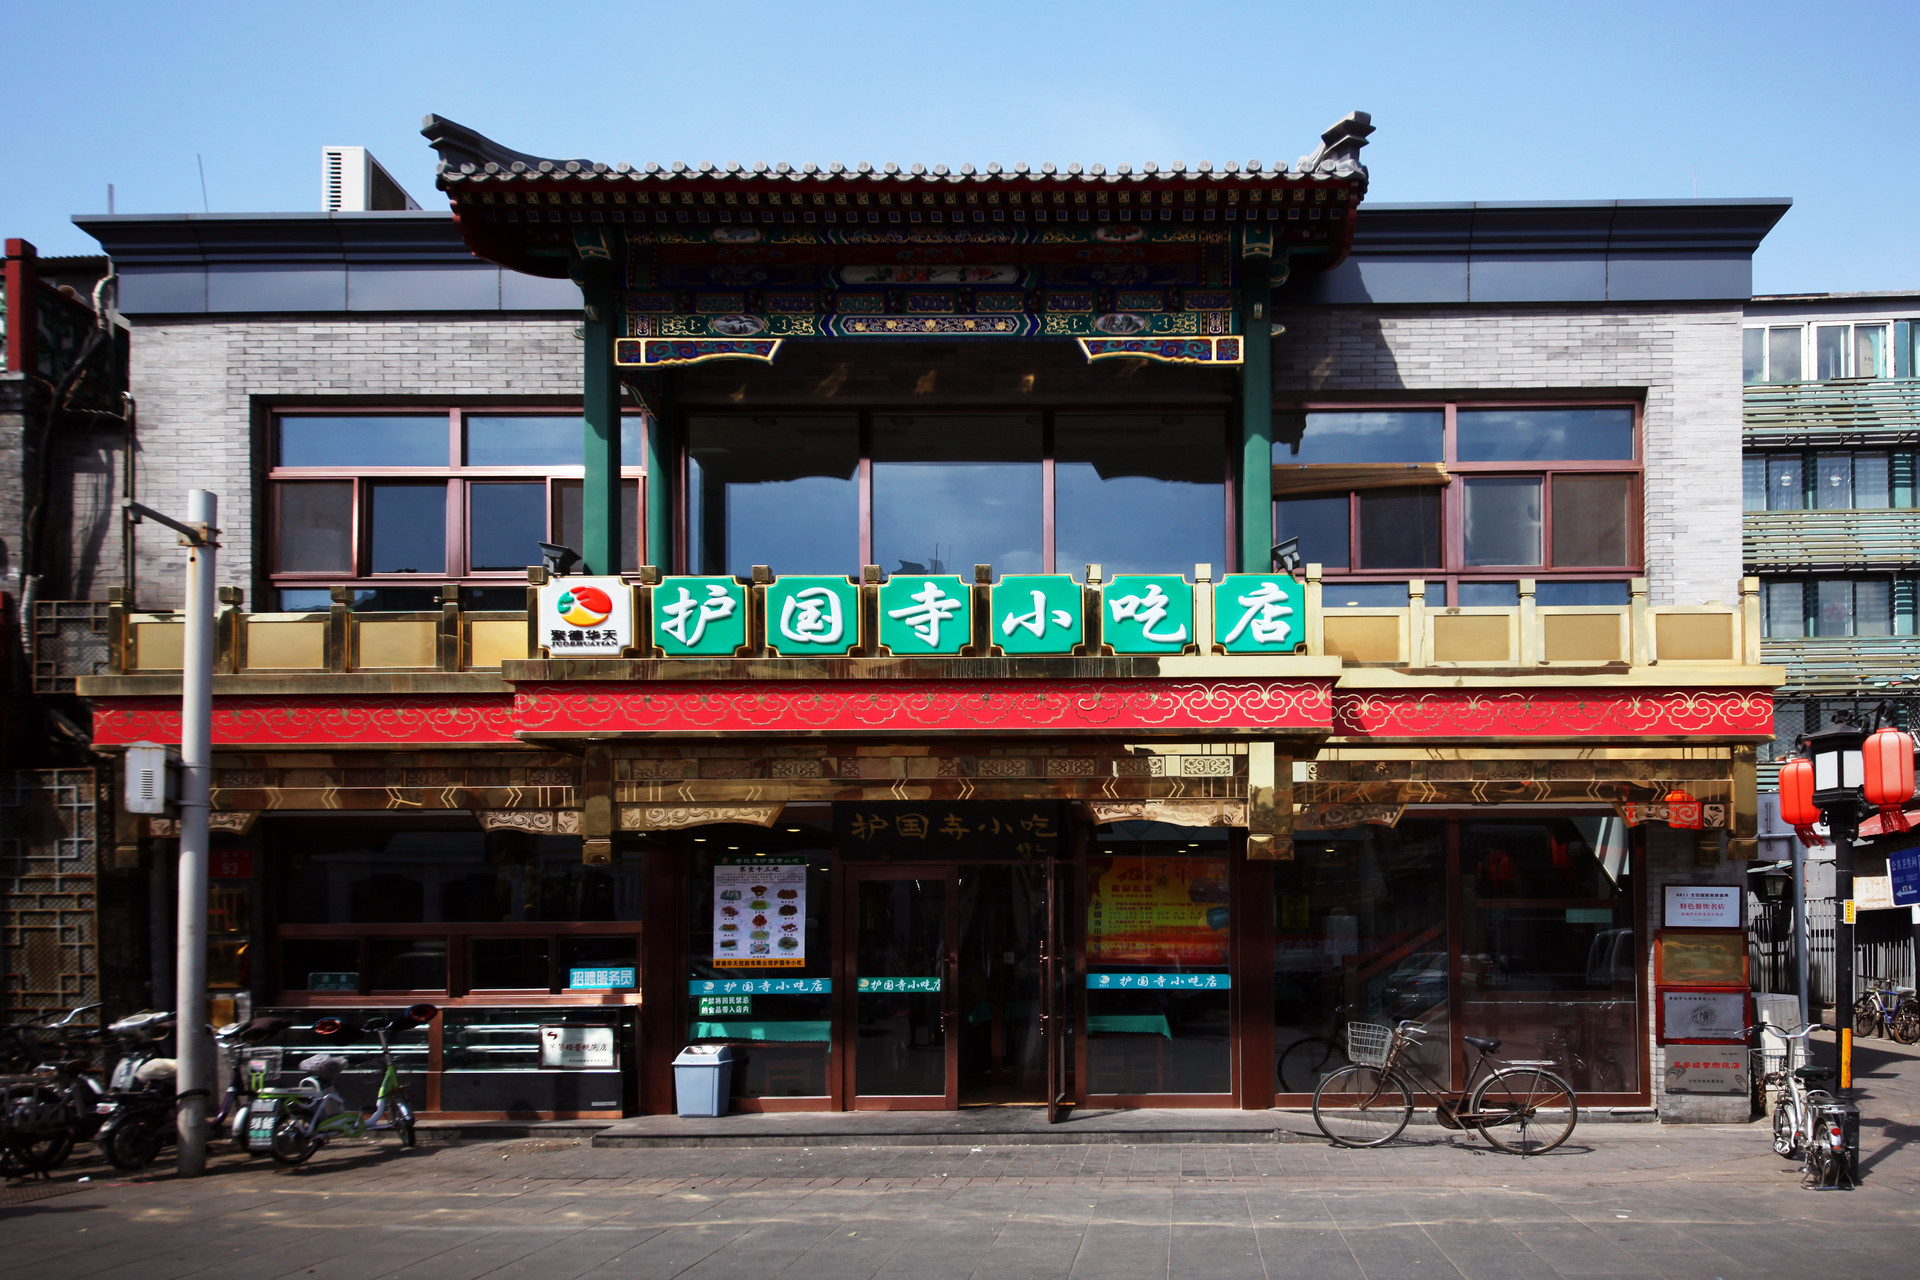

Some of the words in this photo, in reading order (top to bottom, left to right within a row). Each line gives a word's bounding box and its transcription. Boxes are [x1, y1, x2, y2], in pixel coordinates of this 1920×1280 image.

[661, 582, 1295, 648] 护国寺小吃店
[550, 629, 617, 641] 聚德华天
[849, 811, 1058, 841] 护国寺小吃
[1679, 902, 1726, 911] 特色餐饮名店
[571, 969, 632, 987] 招聘服务员
[1119, 974, 1218, 988] 护国寺小吃店
[724, 980, 823, 993] 护国寺小吃店
[701, 996, 749, 1005] 严禁将回民禁忌
[701, 1005, 749, 1014] 的食品带入店内
